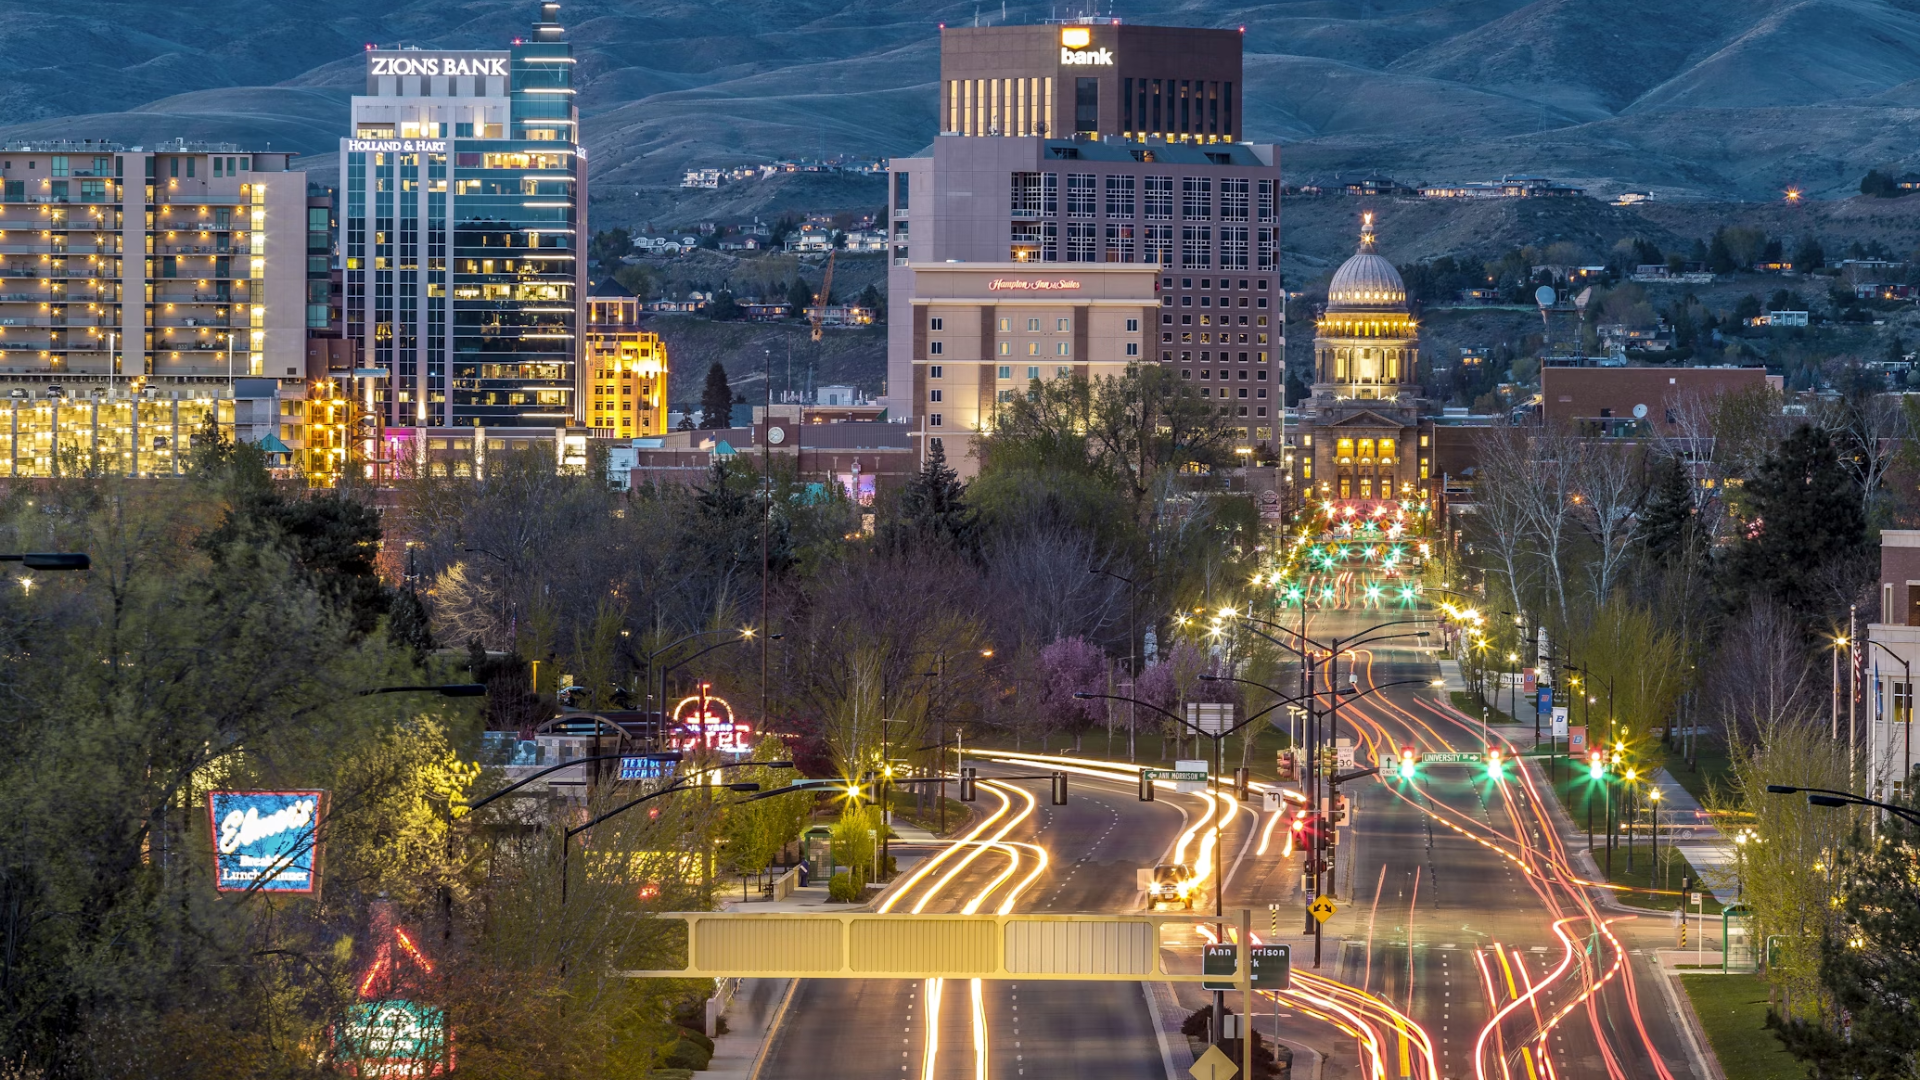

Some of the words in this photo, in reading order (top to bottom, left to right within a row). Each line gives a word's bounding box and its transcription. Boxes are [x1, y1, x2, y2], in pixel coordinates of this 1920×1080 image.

[1061, 47, 1113, 65] bank
[372, 58, 439, 75] ZIONS
[443, 58, 508, 75] BANK
[348, 140, 402, 151] HOLLAND
[404, 141, 414, 151] &
[416, 140, 446, 151] HART
[988, 279, 1031, 291] Hampton
[1031, 280, 1053, 290] Inn
[1057, 279, 1080, 290] Suites
[1556, 715, 1564, 723] B
[1172, 772, 1198, 780] MORRISON
[1209, 947, 1231, 956] Ann
[1249, 947, 1285, 957] rrison
